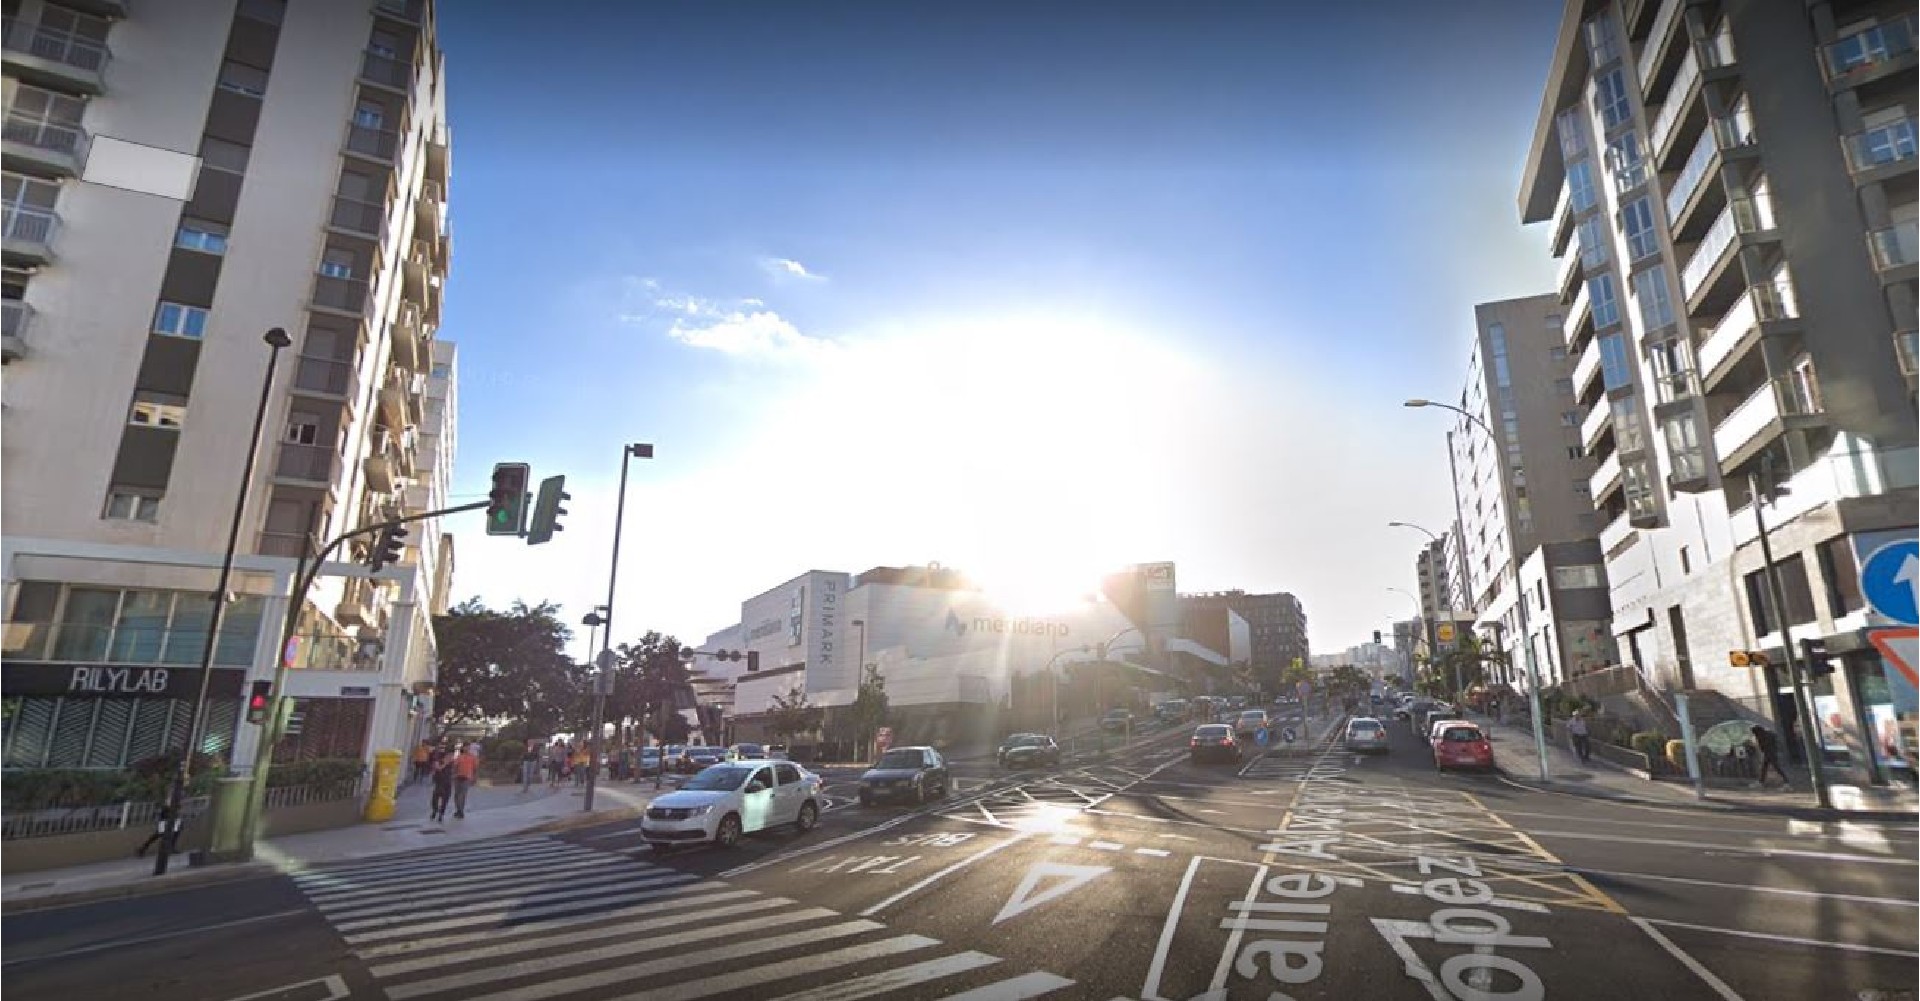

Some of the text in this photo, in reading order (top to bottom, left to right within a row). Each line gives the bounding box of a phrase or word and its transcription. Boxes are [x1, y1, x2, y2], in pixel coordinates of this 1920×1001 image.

[820, 580, 836, 665] PRIMARK
[973, 615, 1070, 637] meridiano
[68, 666, 169, 693] RILYLAB
